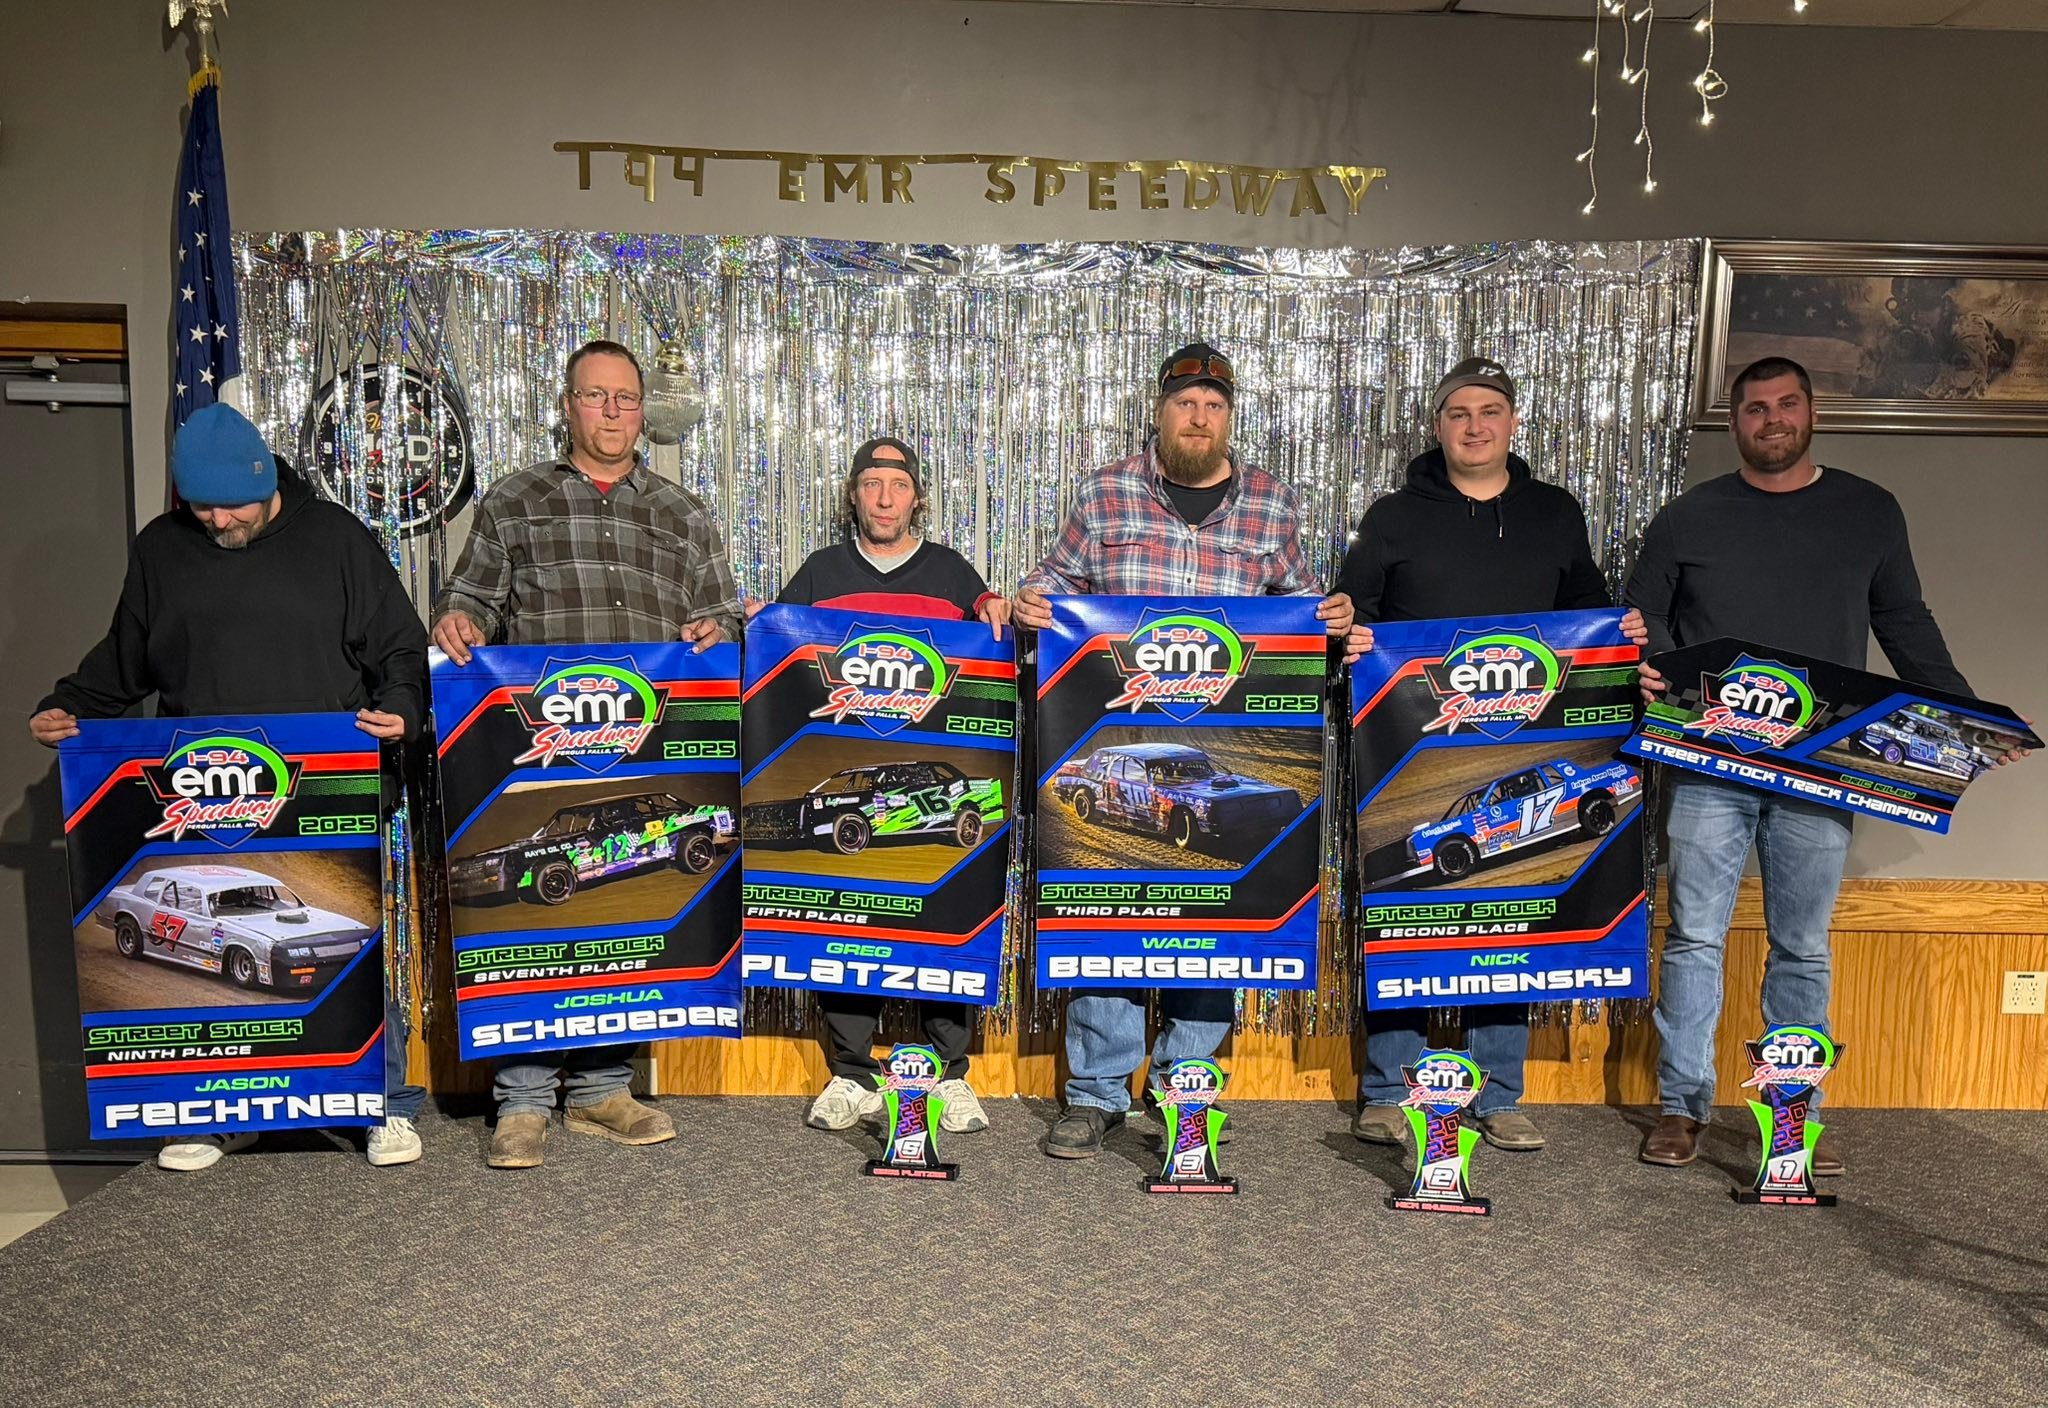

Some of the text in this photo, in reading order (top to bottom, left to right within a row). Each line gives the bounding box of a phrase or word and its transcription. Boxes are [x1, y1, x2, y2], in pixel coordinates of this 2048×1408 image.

[779, 154, 915, 203] EMR
[985, 161, 1378, 217] SPEEDWAY
[1151, 628, 1208, 643] I-94
[859, 643, 913, 662] I-94
[1135, 643, 1220, 672] emr
[1466, 647, 1522, 662] I-94
[841, 657, 925, 690] emr
[1450, 661, 1534, 692] emr
[1739, 672, 1787, 693] I-94
[558, 678, 619, 693] I-94
[1105, 671, 1239, 715] Speedway
[542, 693, 632, 723] emr
[809, 685, 942, 725] Speedway
[1245, 695, 1319, 712] 2025
[1720, 683, 1794, 719] emr
[1422, 689, 1555, 736] Speedway
[1564, 704, 1634, 726] 2025
[946, 715, 1014, 737] 2025
[1645, 725, 1684, 740] 2025
[1683, 706, 1804, 746] Speedway
[513, 721, 654, 768] Speedway
[663, 741, 736, 760] 2025
[187, 750, 249, 765] I-94
[172, 766, 262, 796] emr
[1716, 760, 1776, 784] STOCK
[145, 795, 287, 843] Speedway
[1516, 782, 1566, 841] 17
[299, 815, 377, 835] 2025
[839, 891, 923, 913] STOCK
[1147, 885, 1231, 900] STOCK
[747, 907, 869, 924] FIFTH PLACE
[1055, 906, 1181, 917] THIRD PLACE
[1471, 899, 1556, 917] STOCK
[151, 912, 188, 952] 57
[1380, 923, 1529, 938] SECOND PLACE
[574, 935, 665, 958] STOCK
[826, 942, 893, 958] GREG
[1142, 937, 1217, 949] WADE
[1470, 953, 1530, 967] NICK
[474, 960, 647, 983] SEVENTH PLACE
[554, 988, 664, 1009] JOSHUA
[210, 1020, 303, 1038] STOCK
[108, 1045, 252, 1062] NINTH PLACE
[1762, 1044, 1820, 1065] emr
[890, 1060, 931, 1076] emr
[195, 1076, 290, 1092] JASON
[1170, 1074, 1212, 1090] emr
[1416, 1069, 1467, 1089] emr
[902, 1140, 922, 1156] 5
[1181, 1155, 1201, 1171] 3
[1780, 1159, 1797, 1180] 1
[1430, 1167, 1455, 1187] 2
